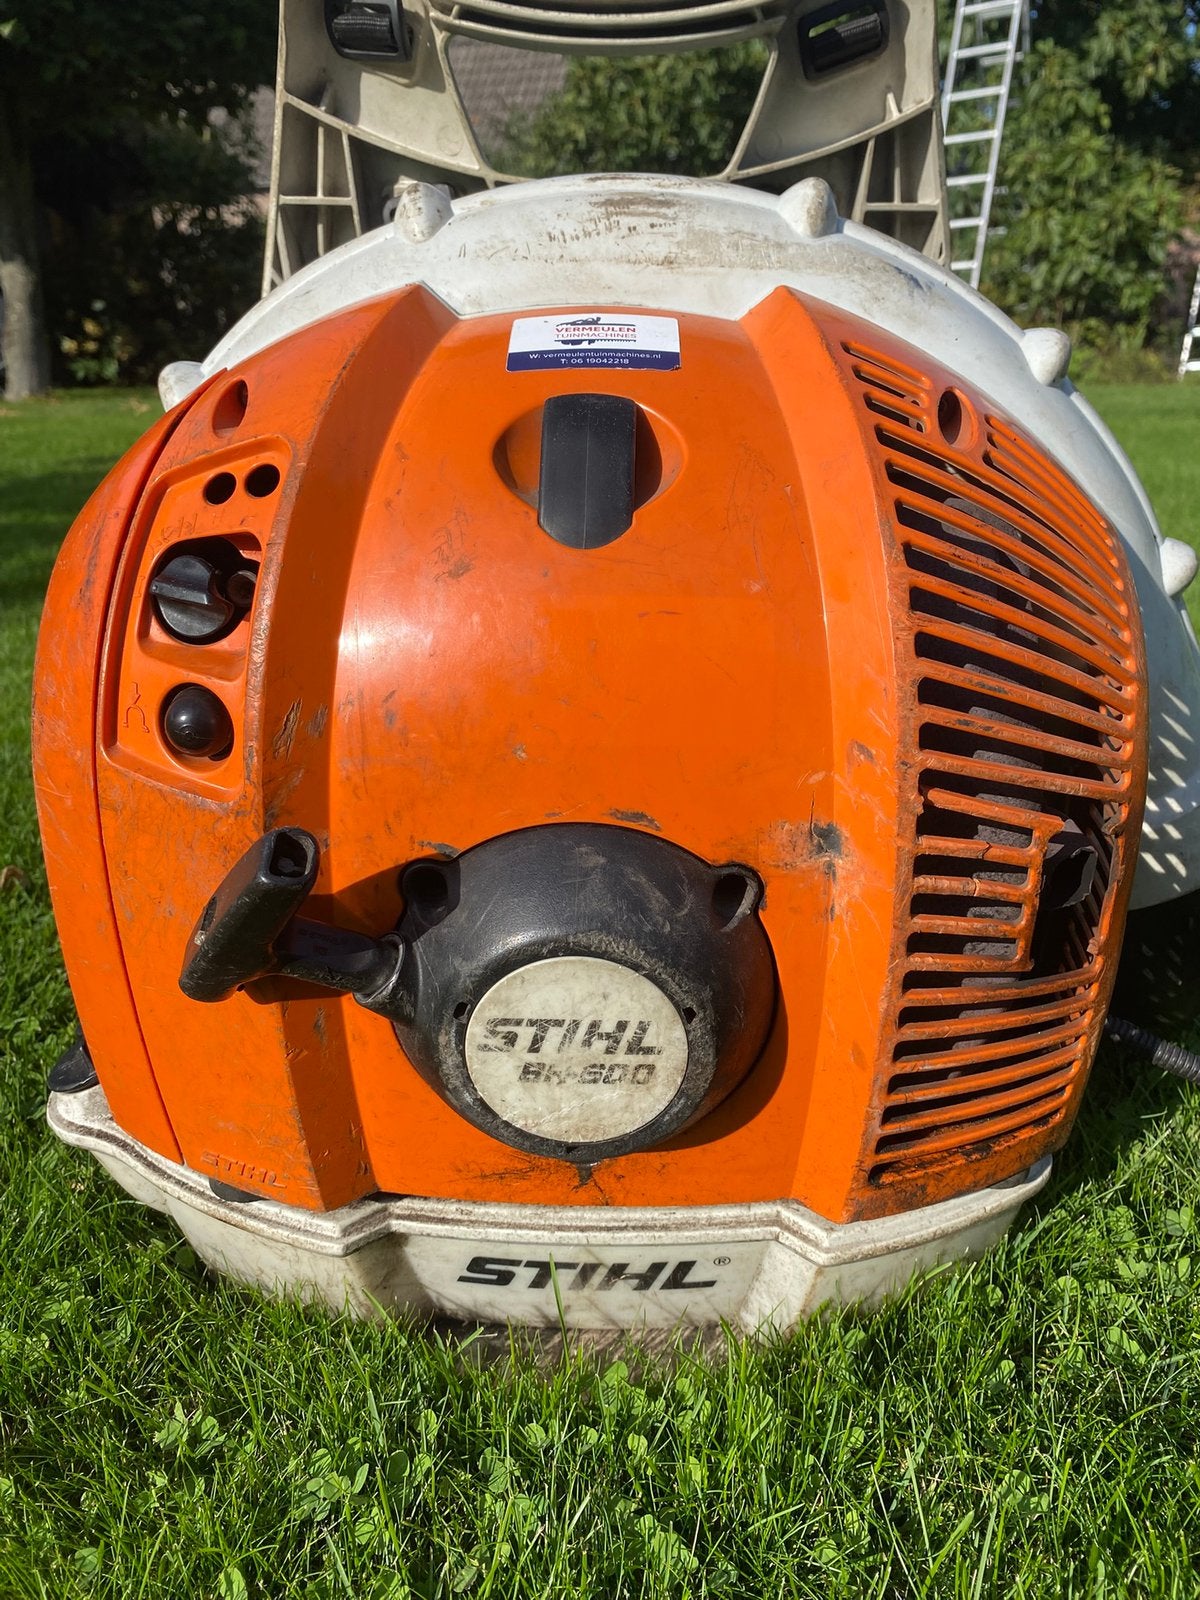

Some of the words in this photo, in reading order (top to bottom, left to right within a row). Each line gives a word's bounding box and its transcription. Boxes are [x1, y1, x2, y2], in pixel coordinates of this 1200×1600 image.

[543, 351, 661, 360] vermeulentuinmachines.nl
[477, 1017, 663, 1056] STIHL
[200, 1149, 288, 1189] STIHL
[457, 1255, 718, 1292] STIHL
